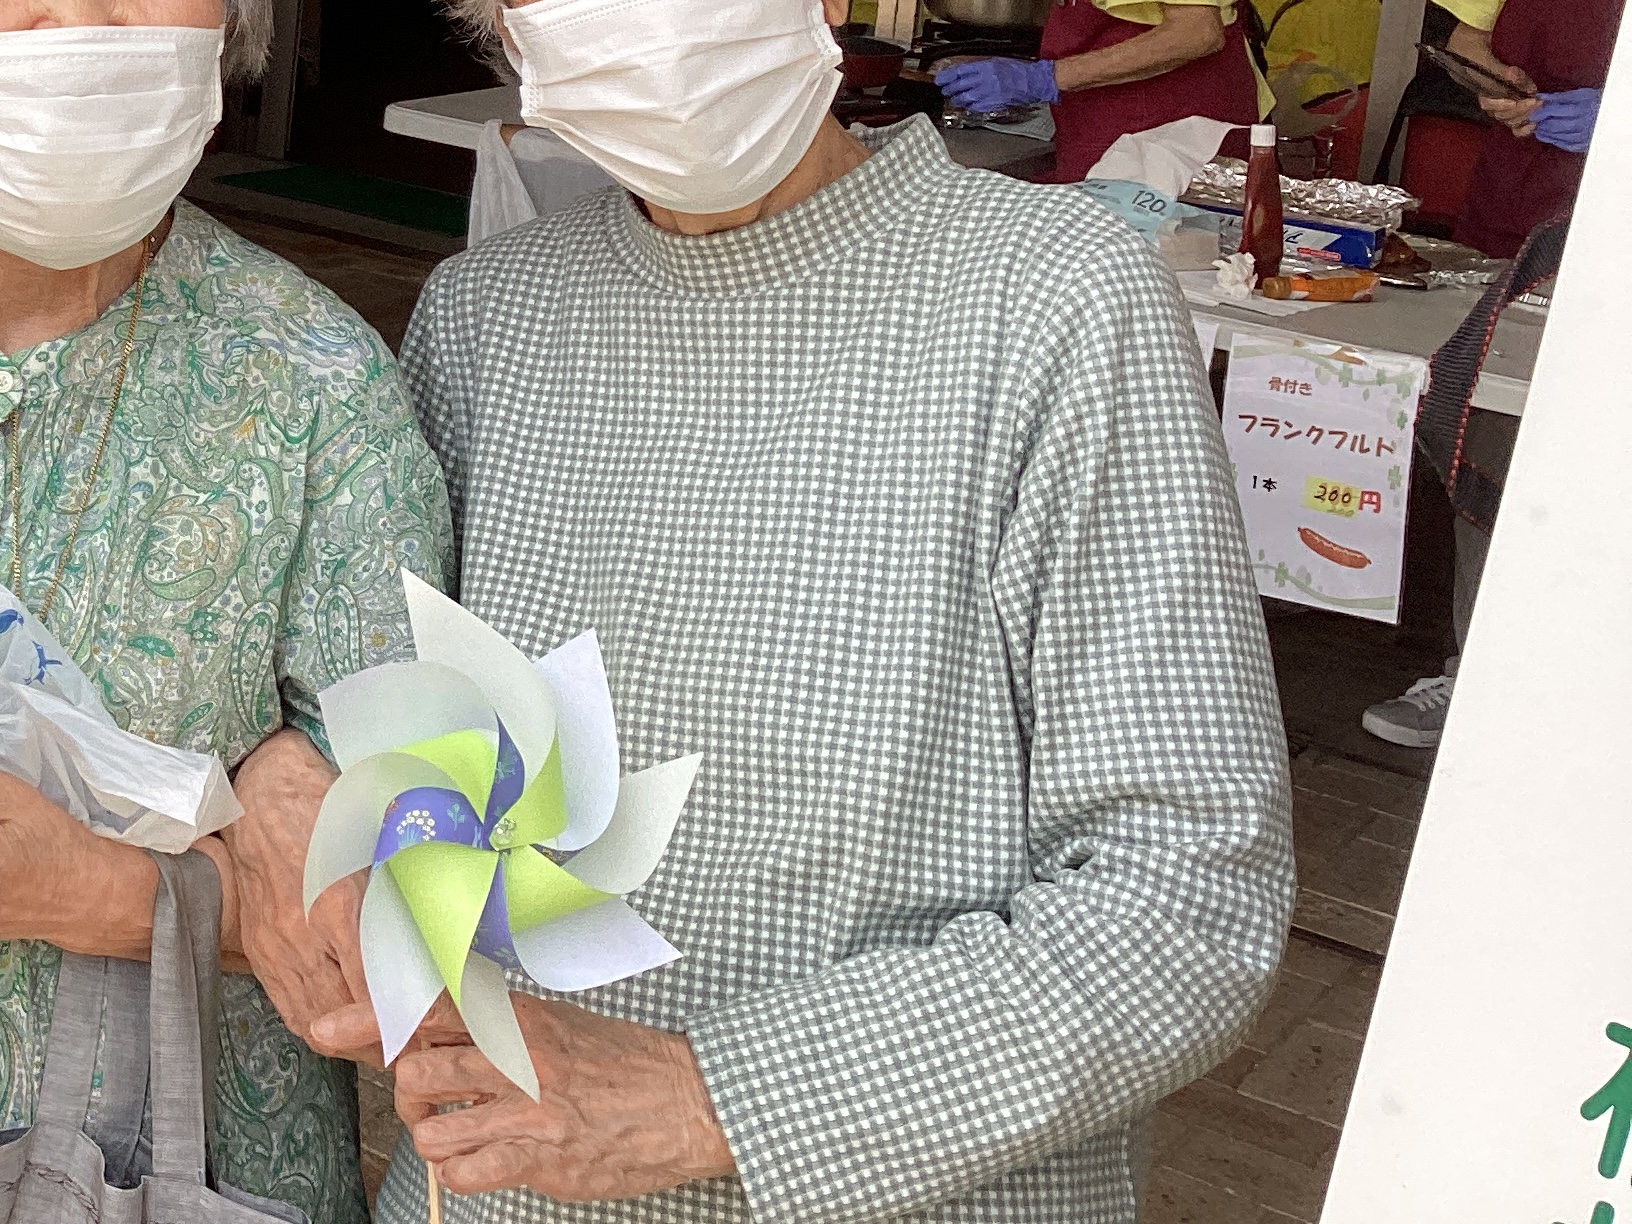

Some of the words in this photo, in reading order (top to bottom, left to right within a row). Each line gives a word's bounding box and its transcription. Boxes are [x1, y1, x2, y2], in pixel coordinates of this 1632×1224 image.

[1132, 190, 1167, 213] 120
[1268, 376, 1313, 397] 骨付き
[1238, 414, 1395, 457] フランクフルト
